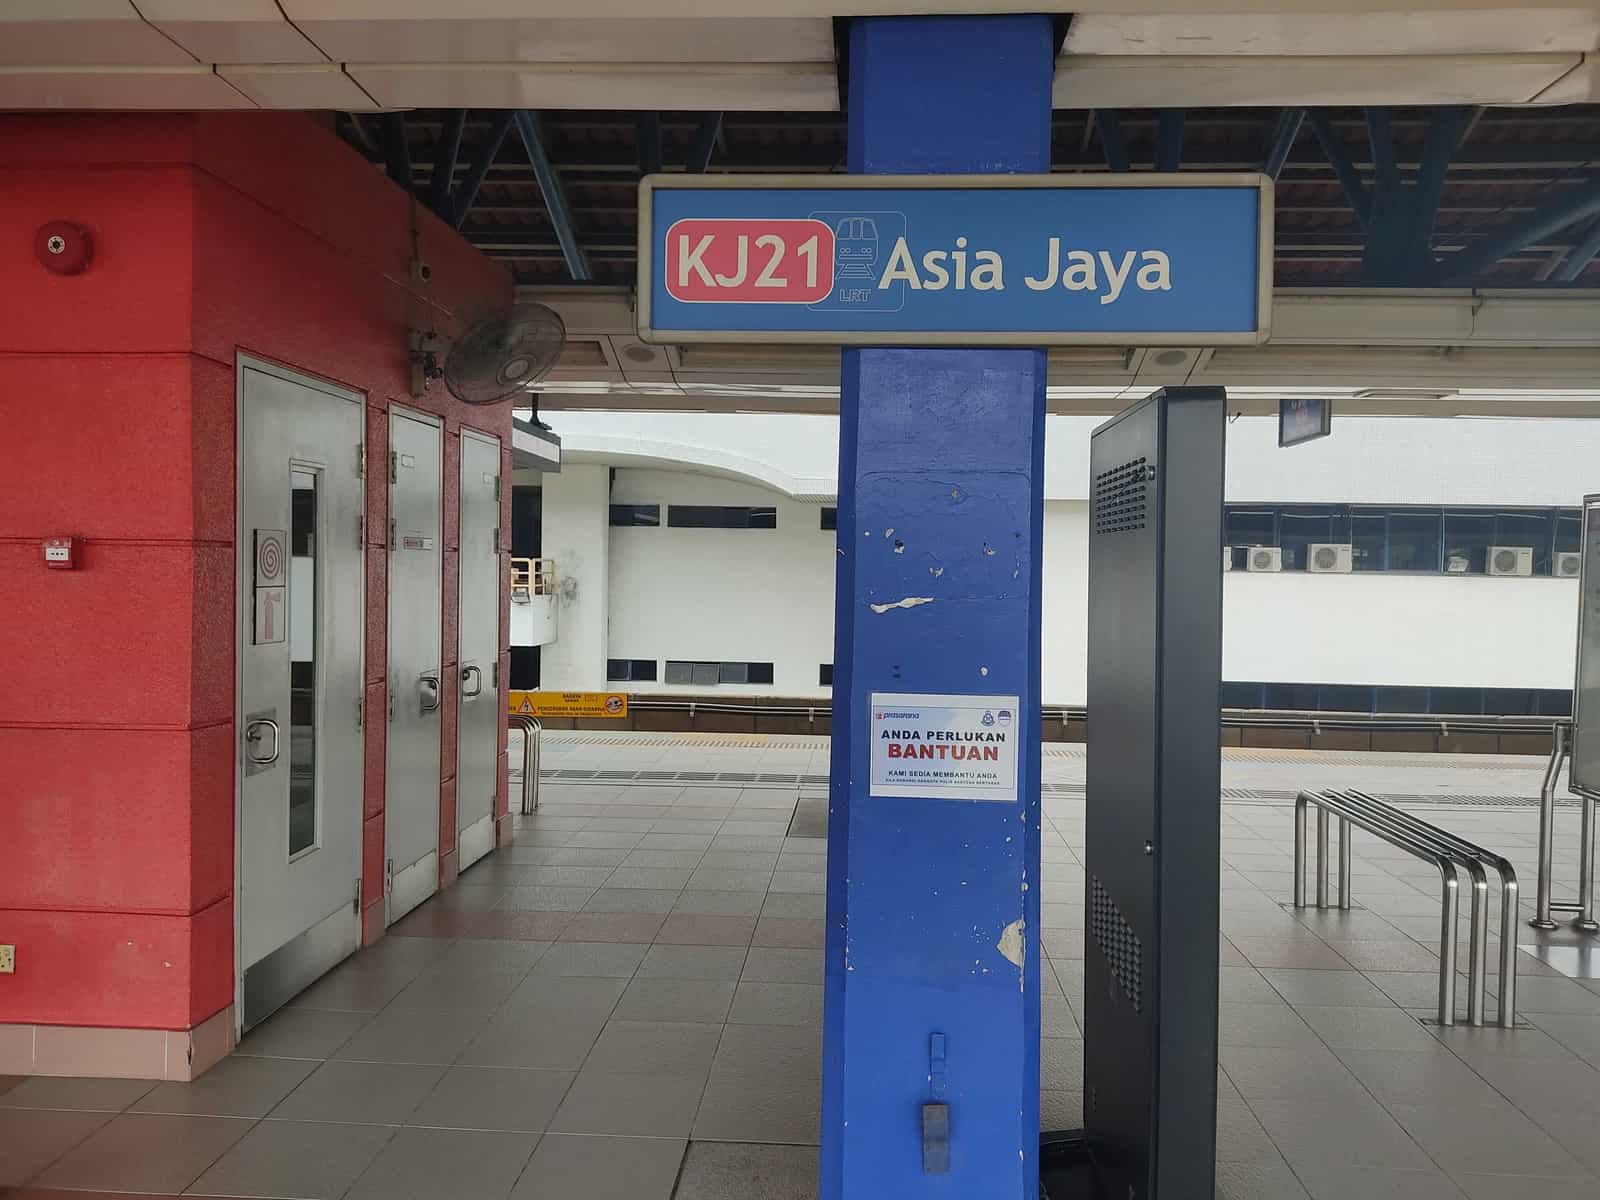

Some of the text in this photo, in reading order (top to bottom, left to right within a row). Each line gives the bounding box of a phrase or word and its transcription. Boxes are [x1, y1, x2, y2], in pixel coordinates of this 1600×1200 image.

[677, 234, 1172, 305] KJ21 Asia Jaya
[839, 288, 872, 303] LRT
[881, 730, 1006, 742] ANDA PERLUKAN
[887, 743, 999, 761] BANTUAN
[888, 769, 997, 780] KAMI SEDIA MEMBANTU ANDA
